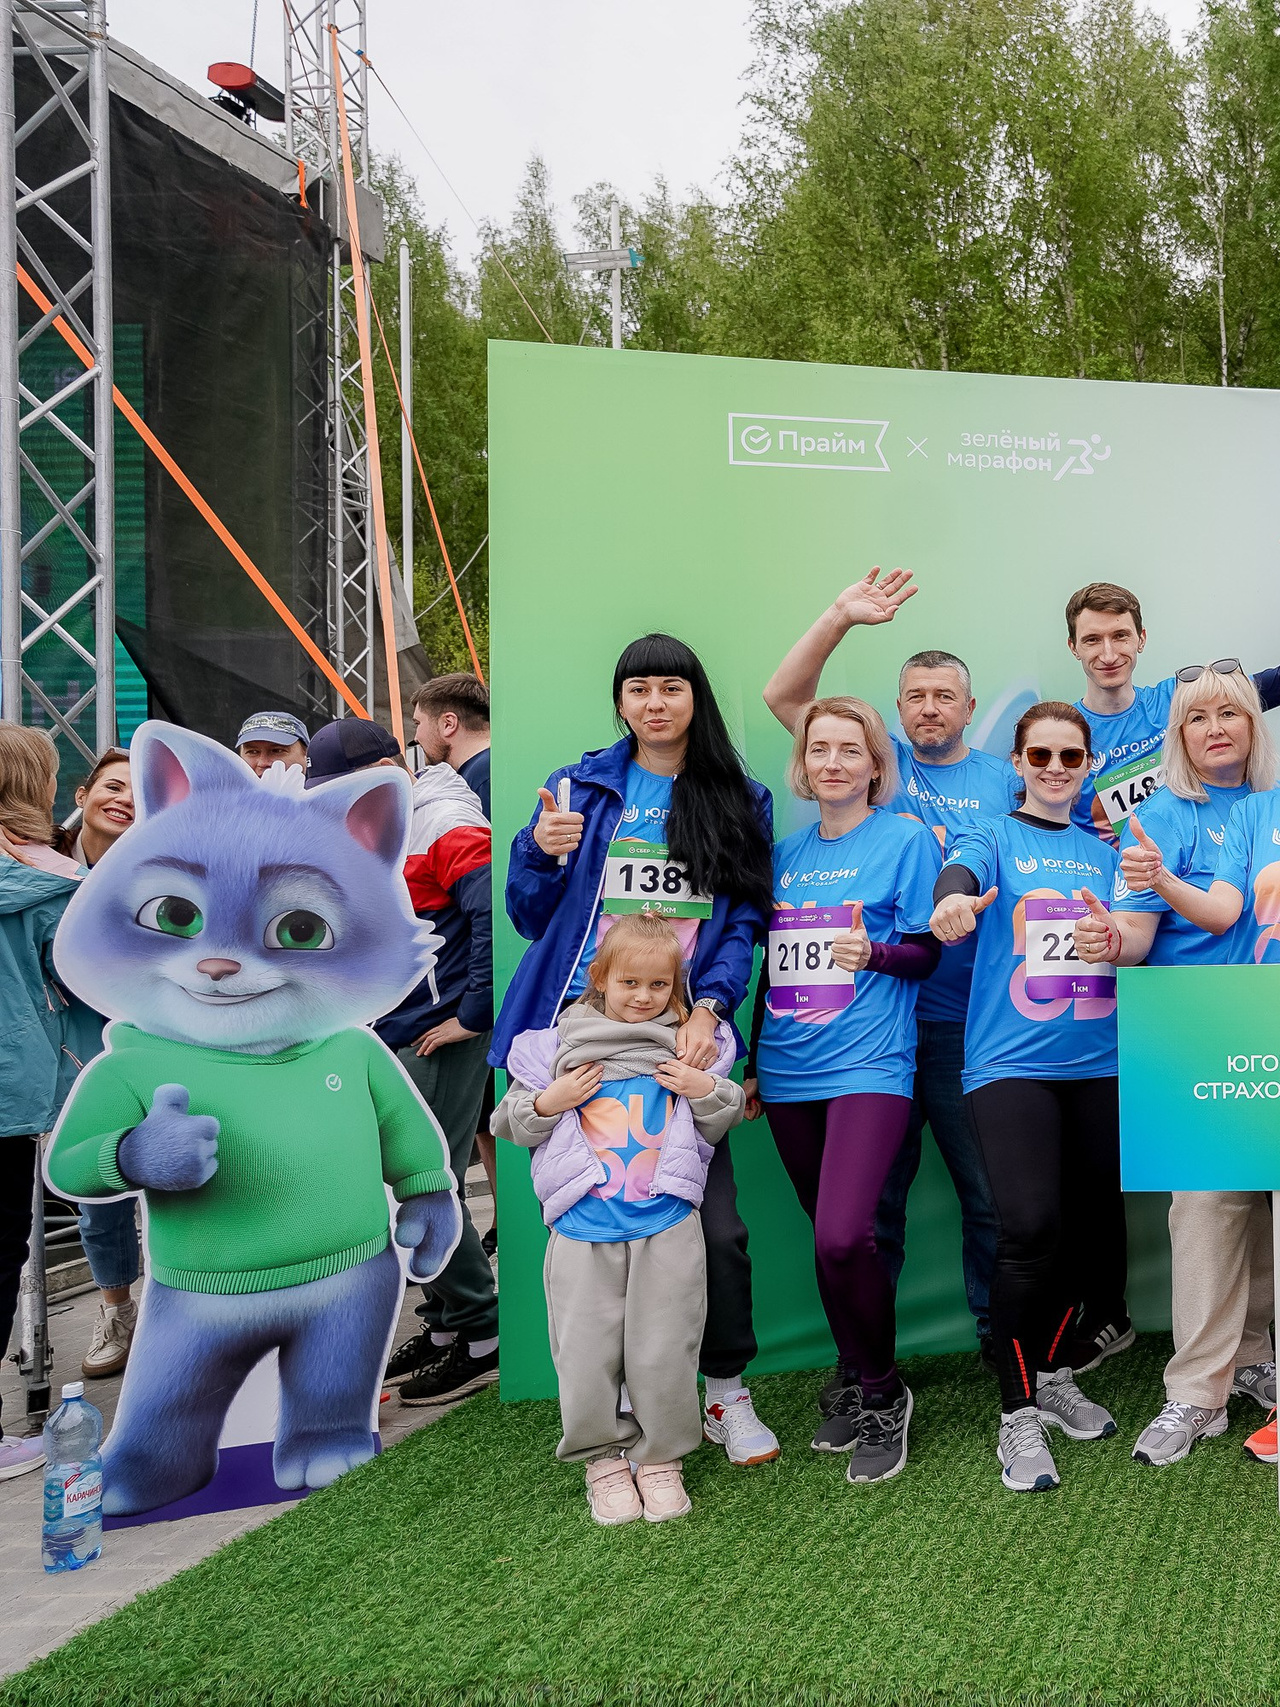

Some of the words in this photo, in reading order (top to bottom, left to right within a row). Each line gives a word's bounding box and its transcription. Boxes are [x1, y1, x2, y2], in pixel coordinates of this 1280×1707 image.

[779, 430, 866, 456] Прайм
[959, 428, 1062, 453] зелёный
[947, 450, 1053, 475] марафон
[1110, 769, 1164, 813] 148
[800, 867, 859, 882] ЮГОРИЯ
[1042, 857, 1103, 876] ЮГОРИЯ
[619, 863, 697, 896] 138
[1042, 932, 1081, 961] 22
